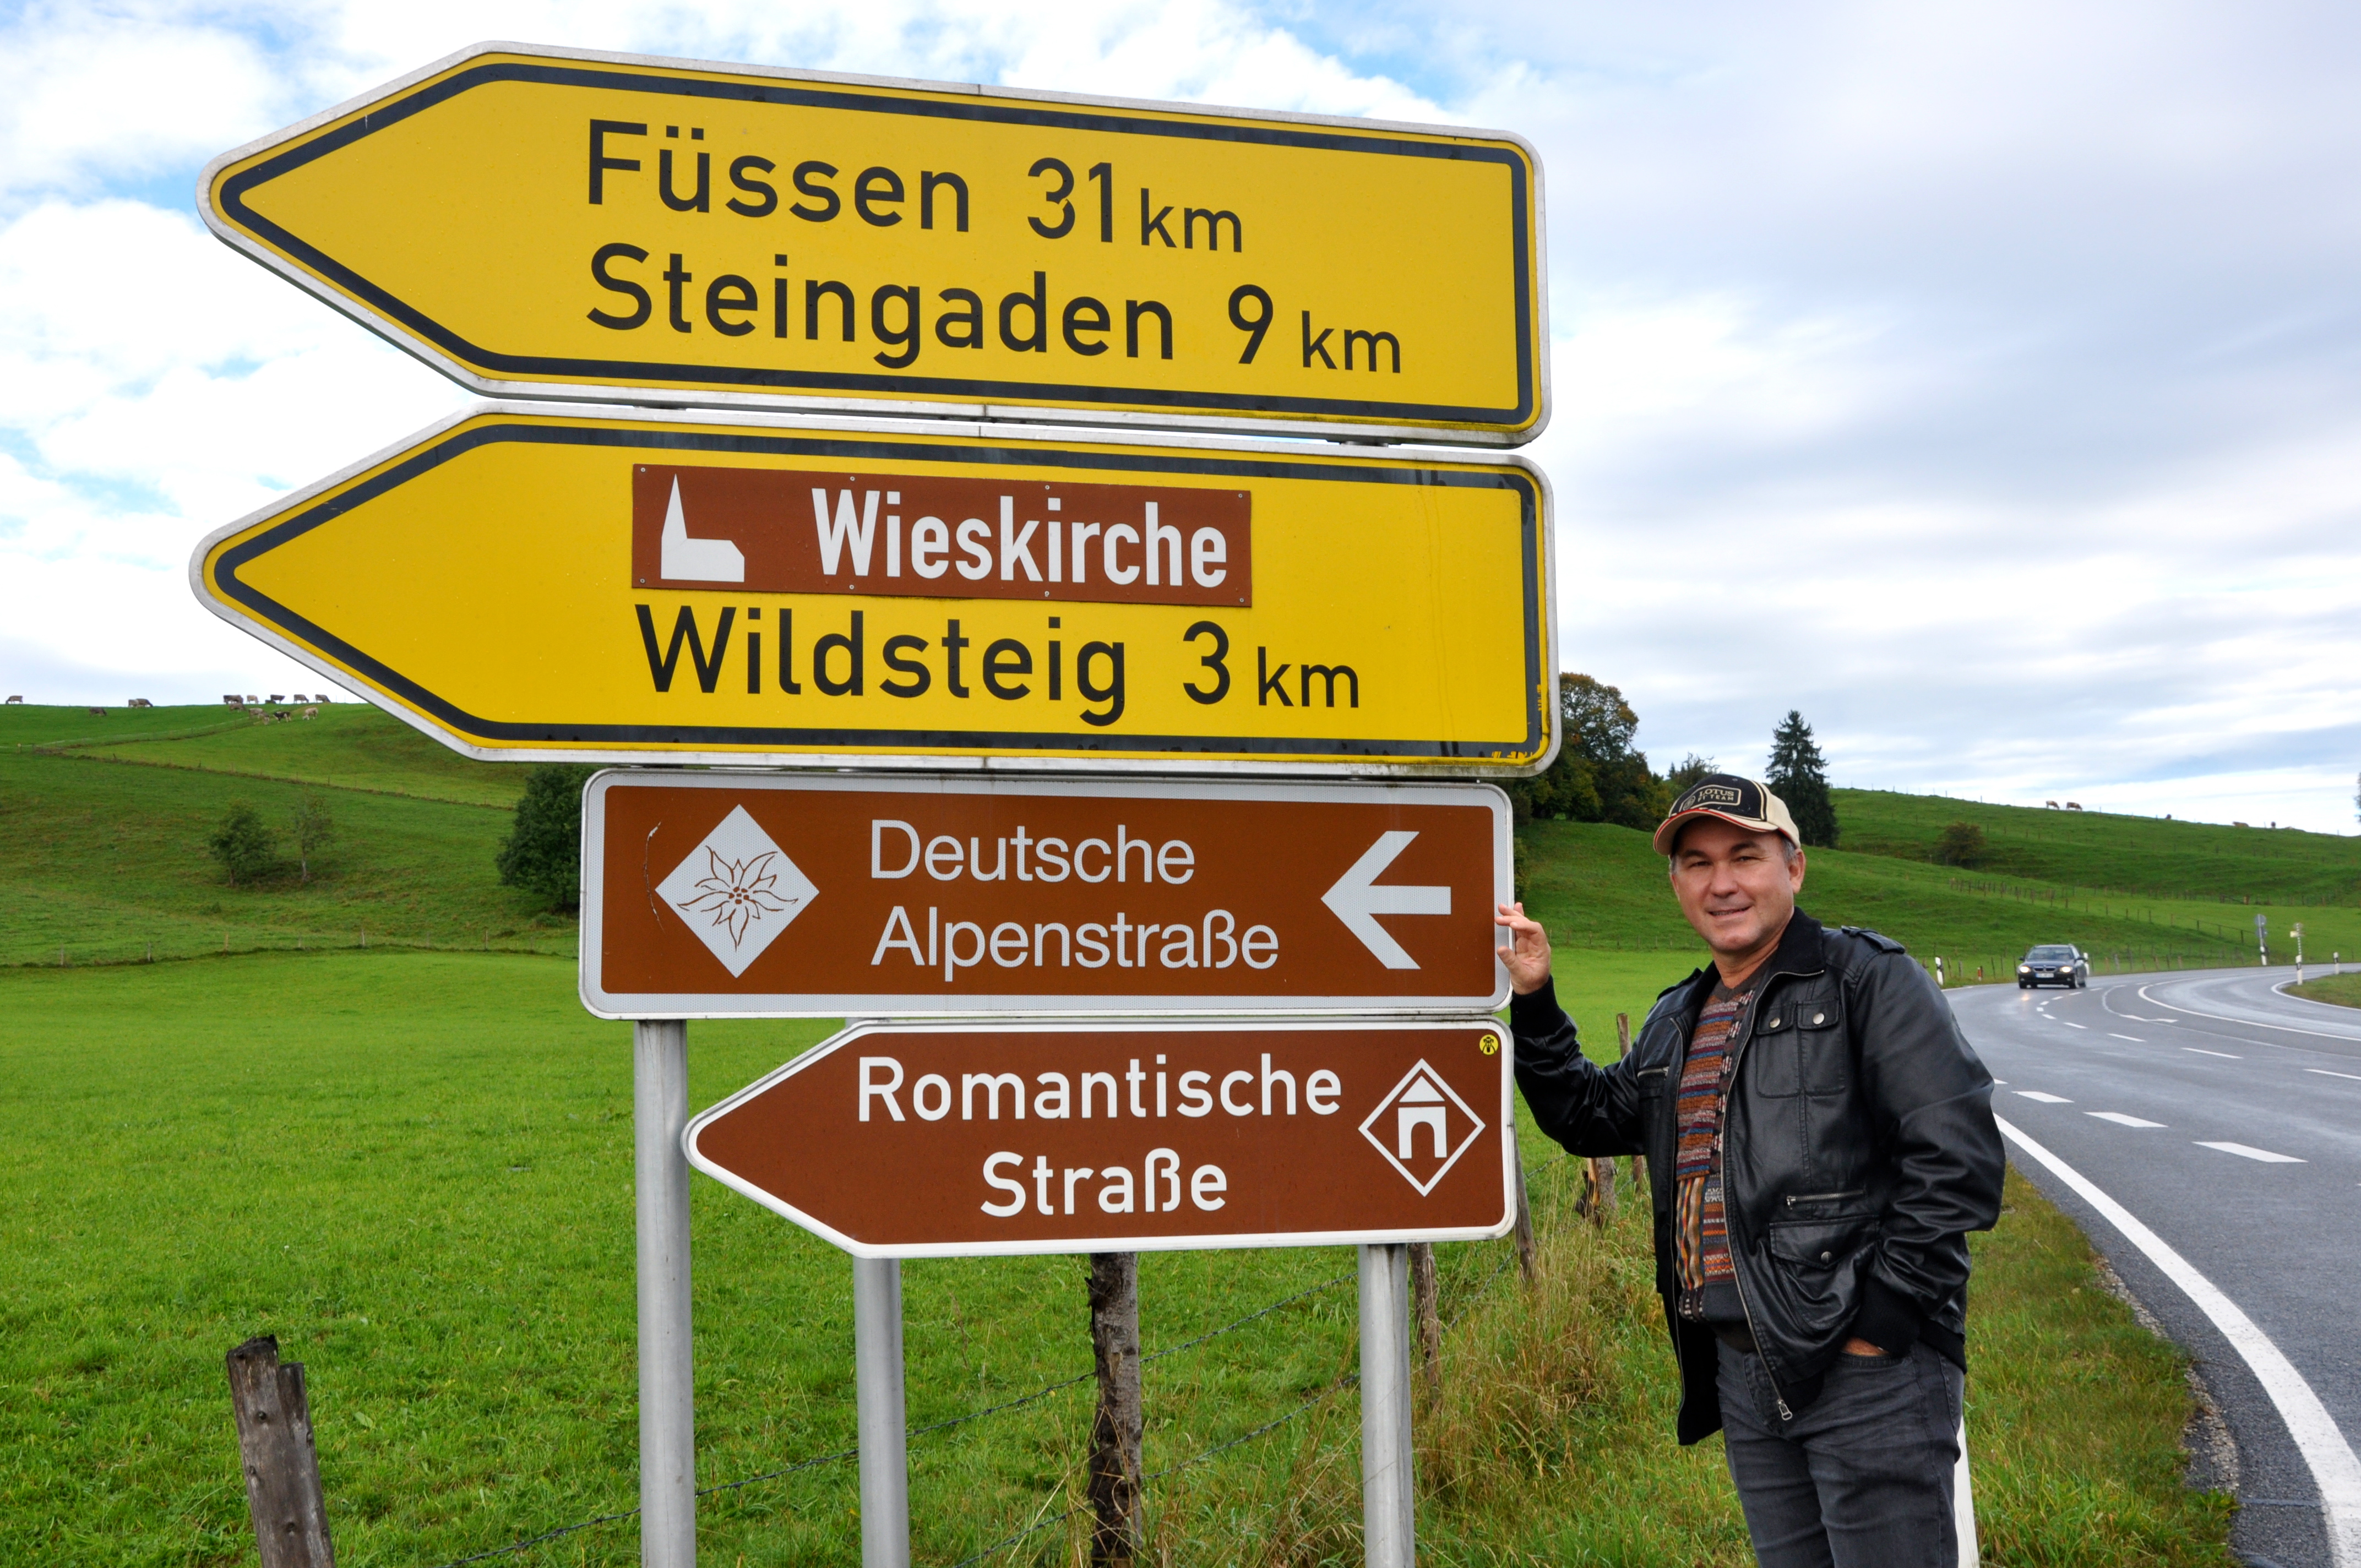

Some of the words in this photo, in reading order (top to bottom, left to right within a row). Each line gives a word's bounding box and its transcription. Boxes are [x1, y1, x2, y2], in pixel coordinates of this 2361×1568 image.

[589, 119, 968, 232] Füssen
[1028, 158, 1112, 242] 31
[1141, 188, 1241, 252] km
[587, 243, 1172, 368] Steingaden
[1228, 285, 1273, 364] 9
[1302, 311, 1400, 373] km
[812, 488, 1226, 587] Wieskirche
[635, 605, 1124, 726] Wildsteig
[1183, 621, 1230, 704] 3
[1258, 647, 1358, 707] km
[1699, 788, 1734, 797] LOTUS
[872, 820, 1194, 884] Deutsche
[871, 906, 1278, 982] Alpenstraße
[859, 1053, 1341, 1121] Romantische
[981, 1148, 1227, 1217] Straße
